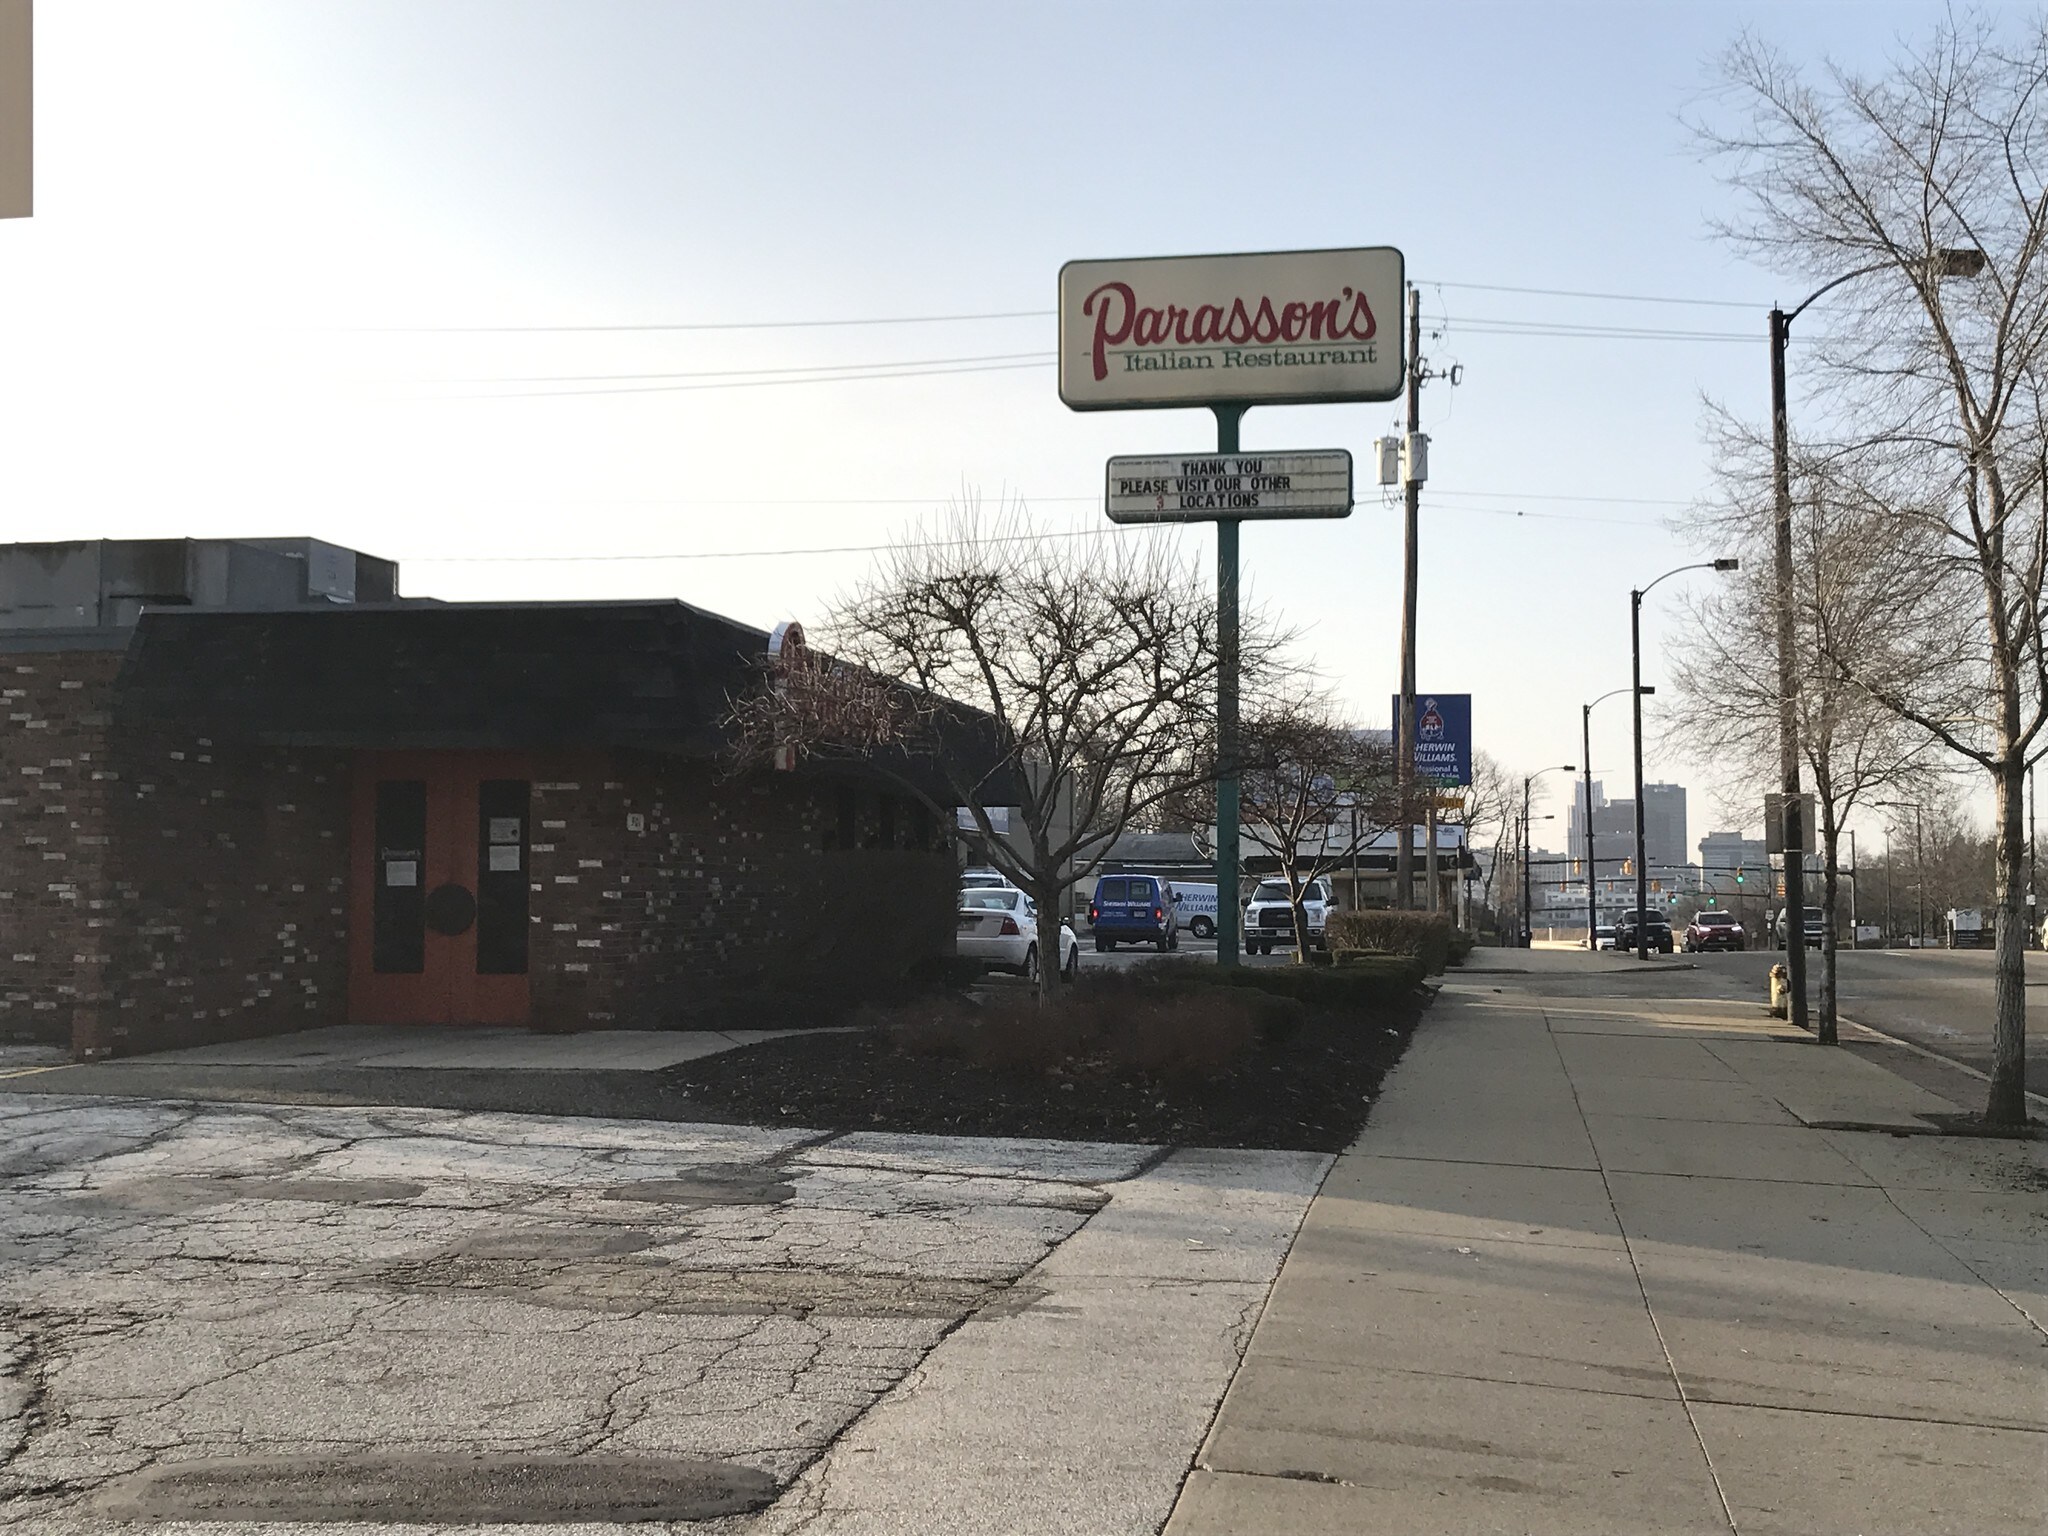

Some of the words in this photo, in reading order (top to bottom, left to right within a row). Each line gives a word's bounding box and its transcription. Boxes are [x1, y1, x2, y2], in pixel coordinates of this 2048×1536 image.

[1083, 282, 1377, 381] Parasson's
[1124, 352, 1215, 373] Italian
[1222, 346, 1378, 368] Restaurant
[1182, 461, 1226, 476] THANK
[1236, 460, 1263, 474] YOU
[1120, 480, 1168, 494] PLEASE
[1176, 477, 1209, 492] VISIT
[1214, 478, 1241, 491] OUR
[1250, 476, 1290, 491] OTHER
[1180, 493, 1259, 508] LOCATIONS
[1414, 742, 1456, 752] HERWIN
[1181, 894, 1218, 902] HERWIN
